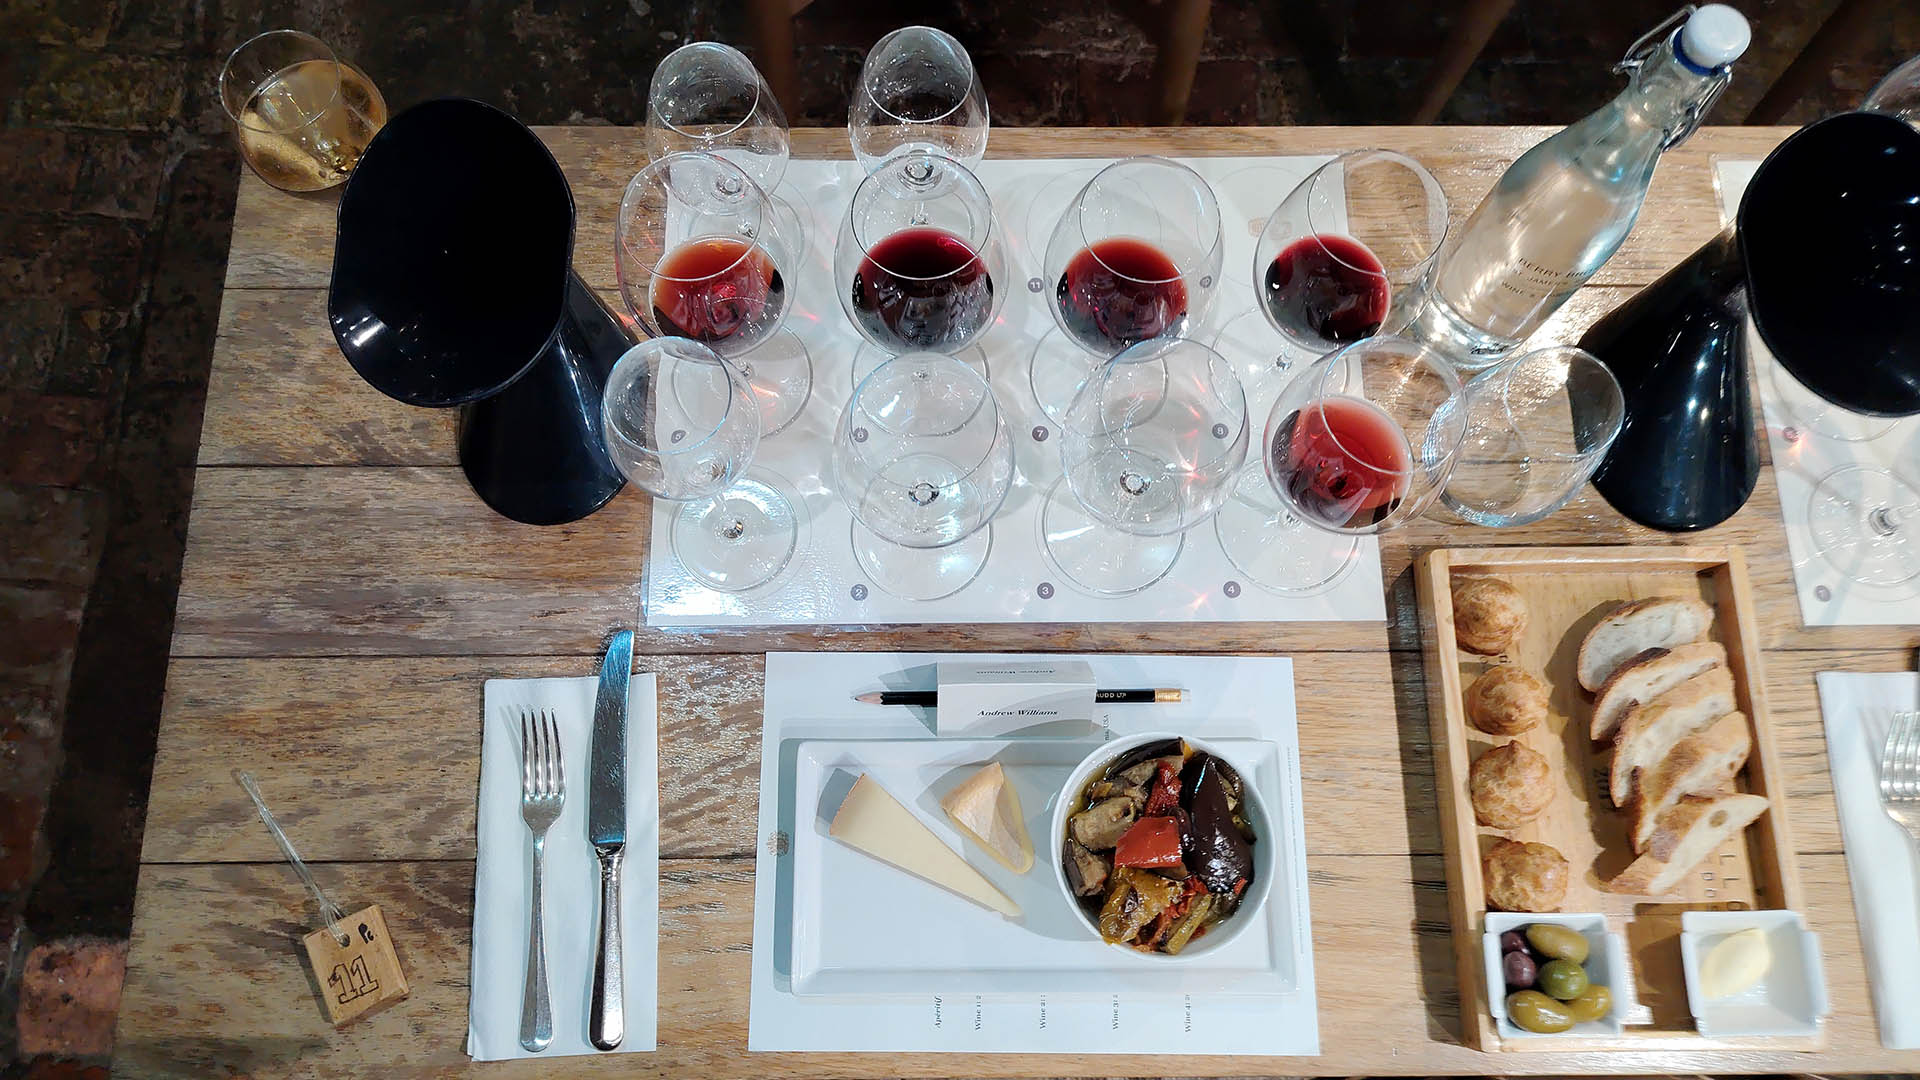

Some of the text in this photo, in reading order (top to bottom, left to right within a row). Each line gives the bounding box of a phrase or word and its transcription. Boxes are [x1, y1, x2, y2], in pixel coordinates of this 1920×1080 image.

[977, 708, 1058, 717] Andrew Williams
[327, 955, 379, 1004] 11
[974, 1009, 982, 1031] Wine
[1111, 1008, 1119, 1030] Wine
[1183, 1011, 1192, 1033] Wine
